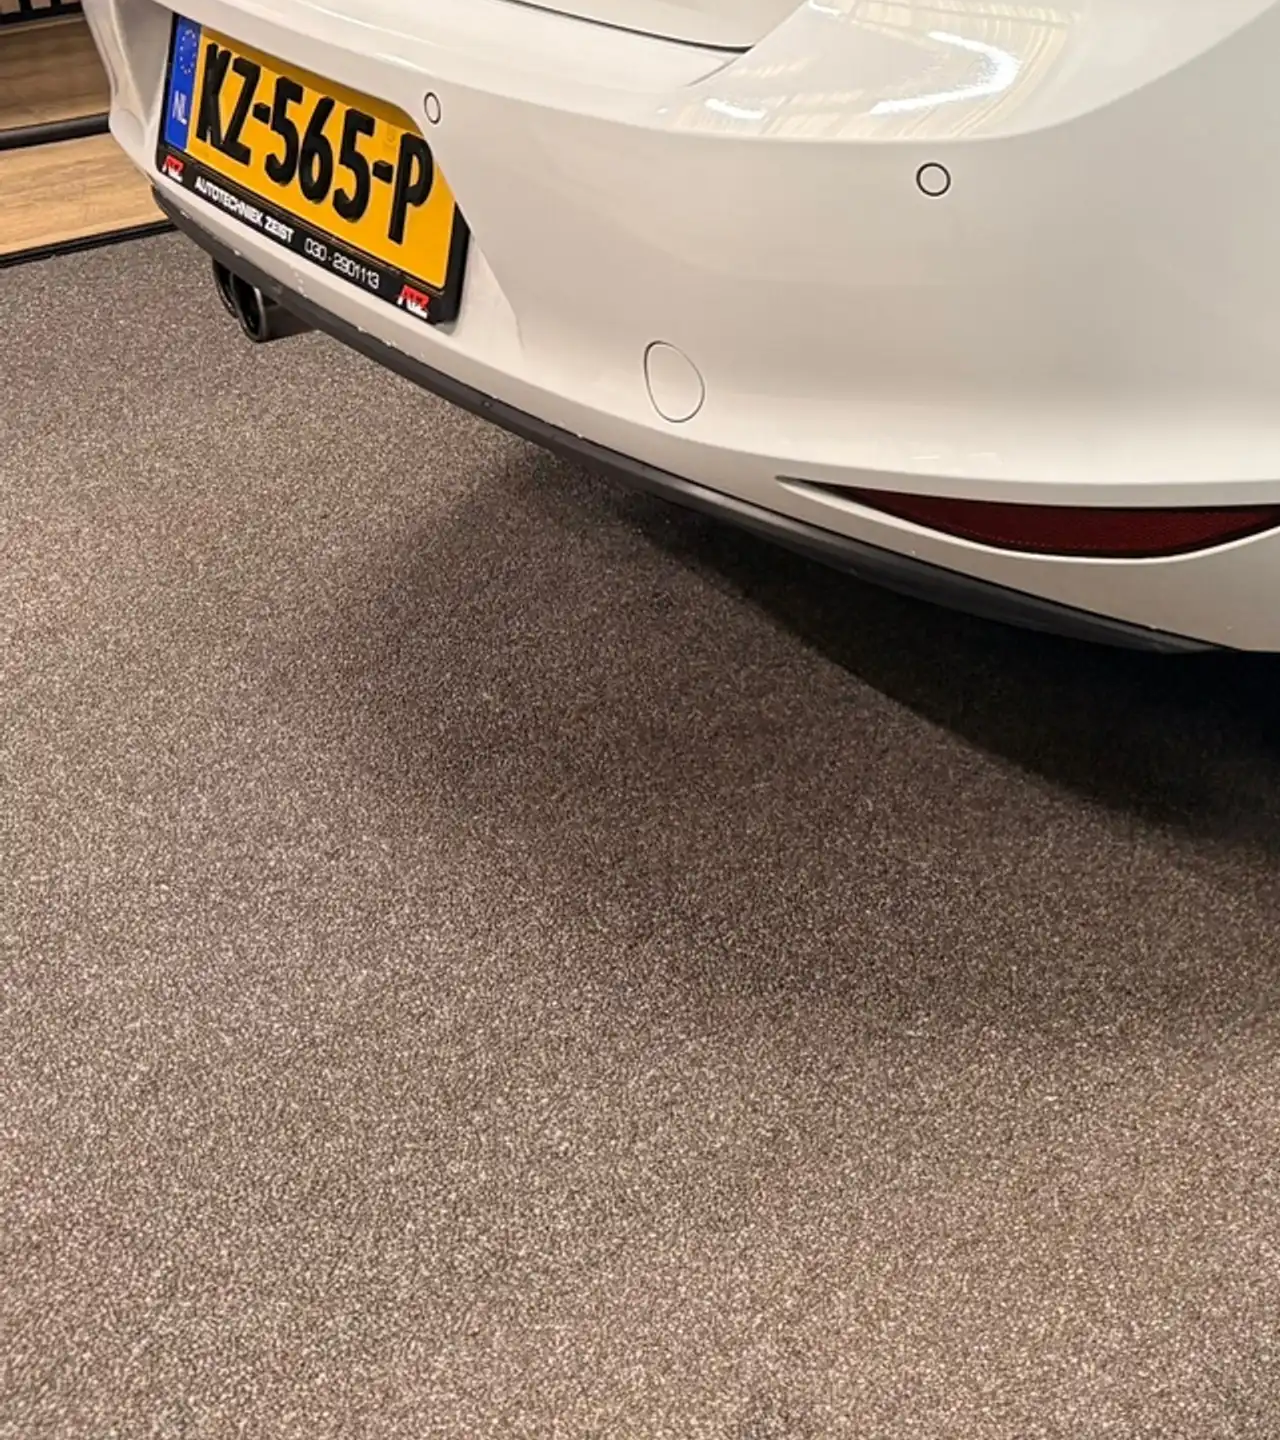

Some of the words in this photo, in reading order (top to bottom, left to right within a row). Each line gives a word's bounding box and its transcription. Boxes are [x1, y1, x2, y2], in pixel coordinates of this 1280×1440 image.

[172, 90, 187, 125] NL
[197, 44, 433, 245] KZ-565-P
[195, 177, 263, 225] AUTOTECHNIEK
[264, 216, 295, 243] ZEIST
